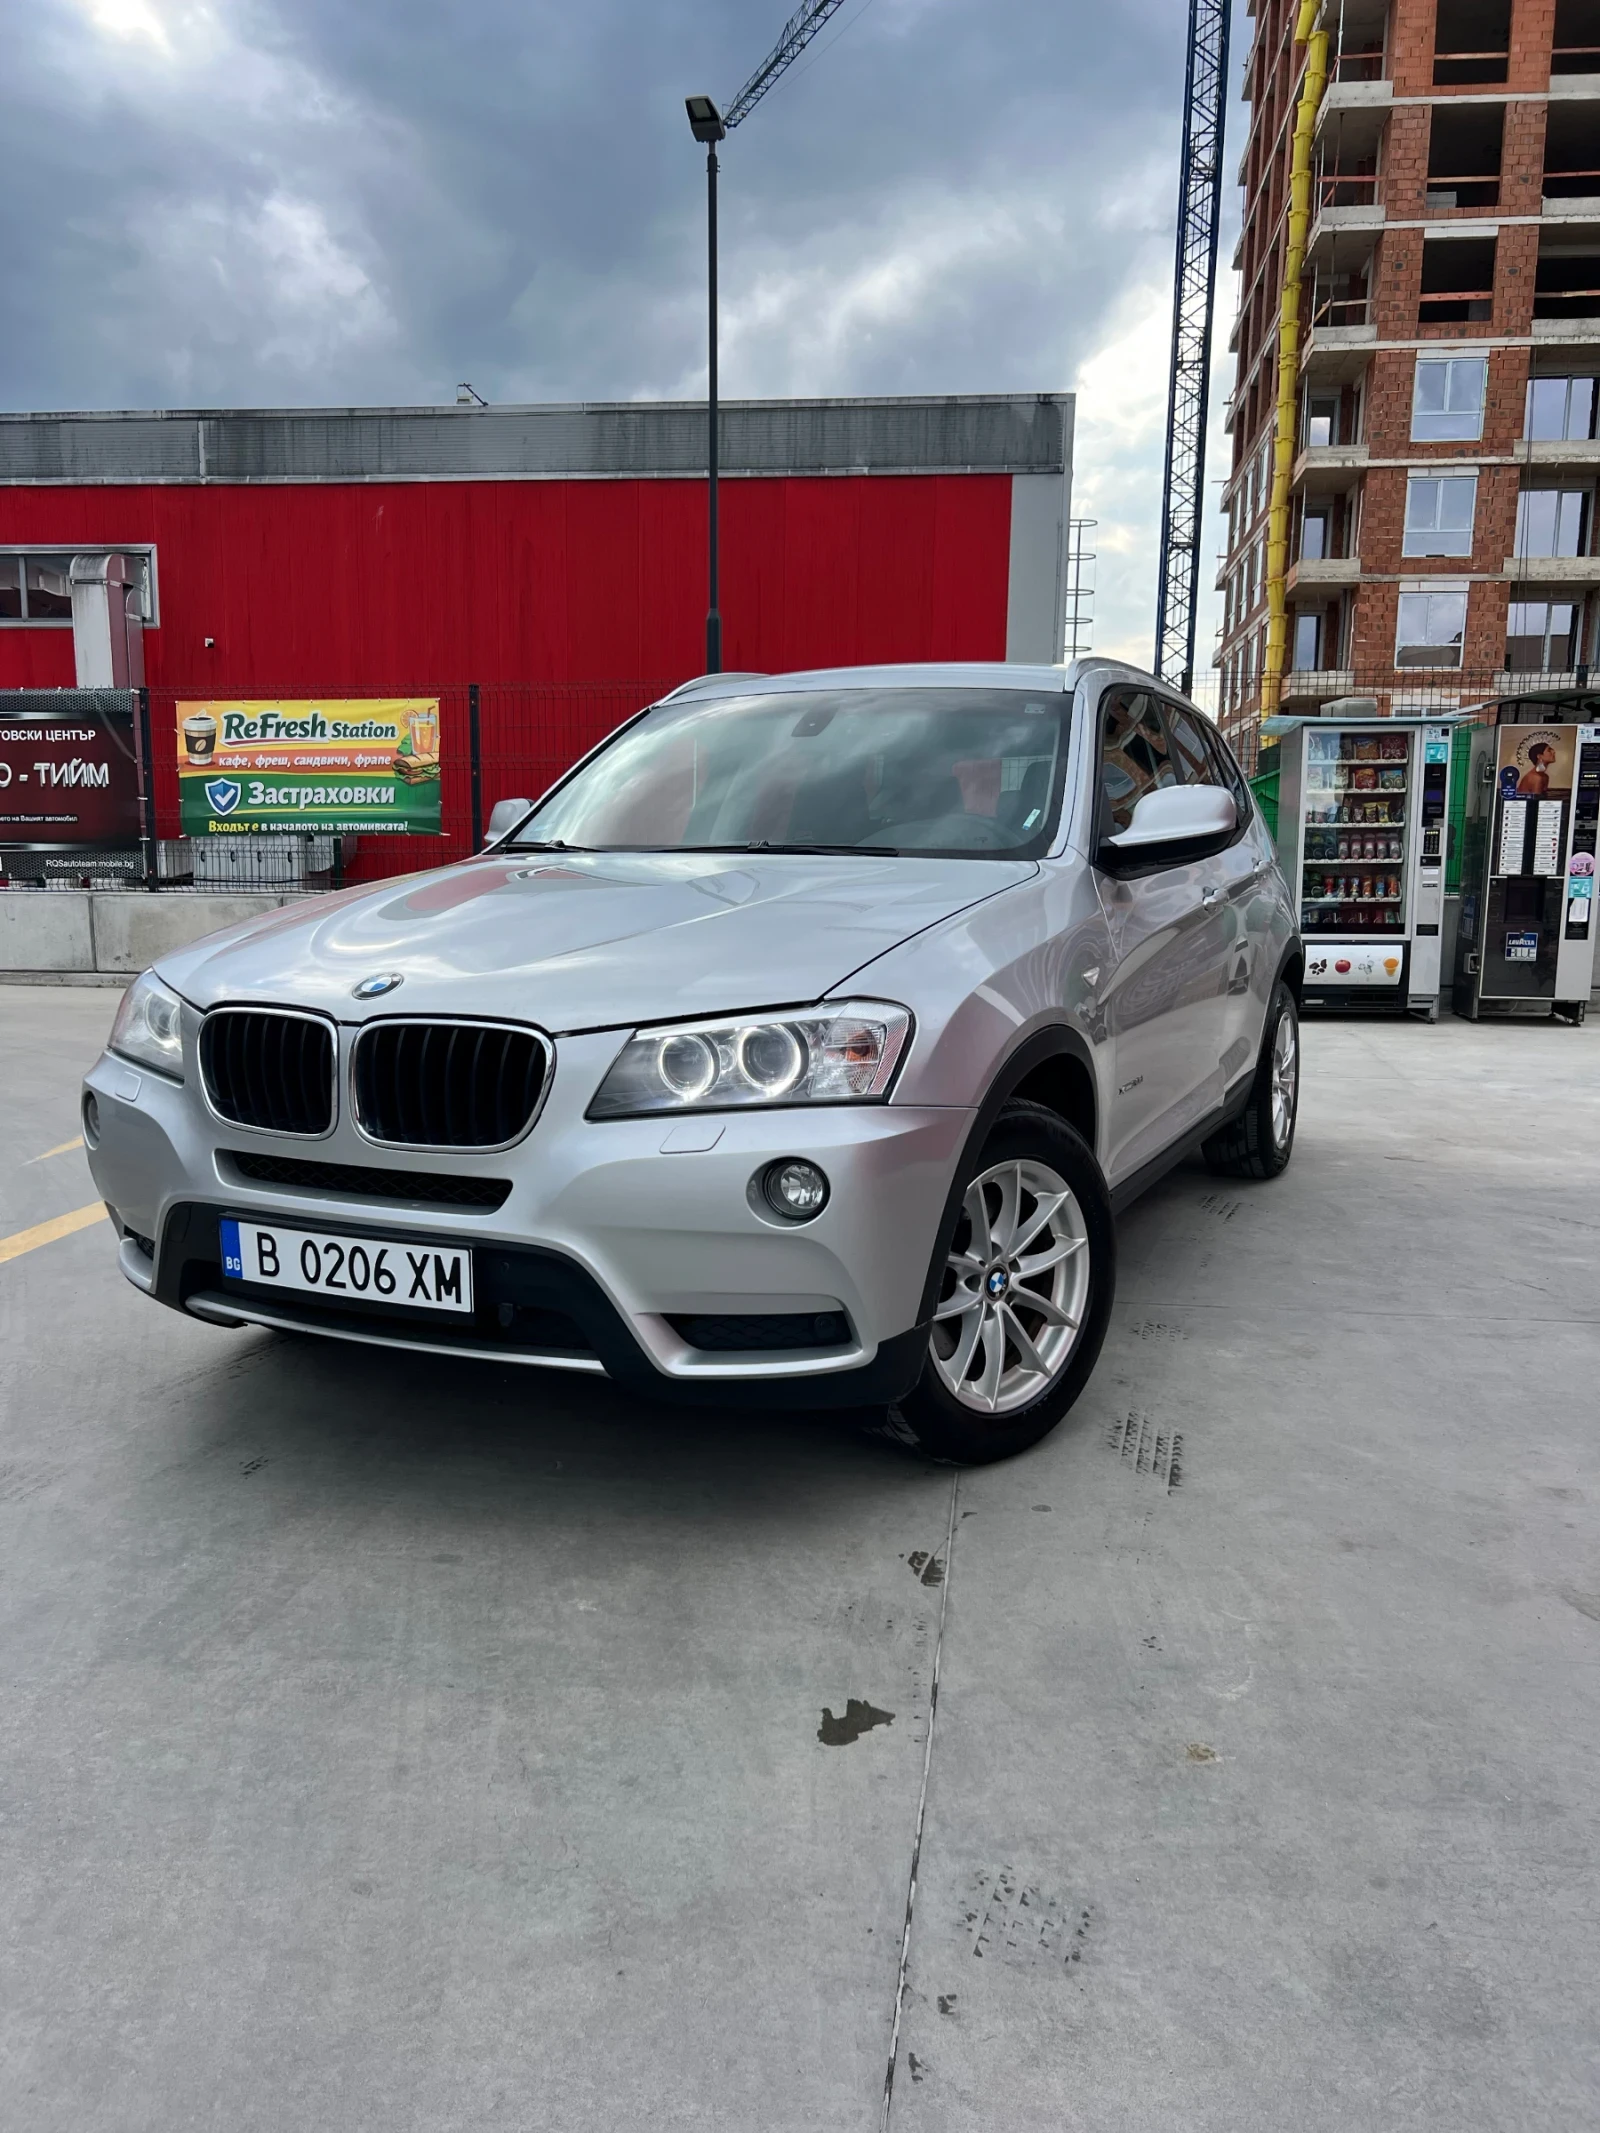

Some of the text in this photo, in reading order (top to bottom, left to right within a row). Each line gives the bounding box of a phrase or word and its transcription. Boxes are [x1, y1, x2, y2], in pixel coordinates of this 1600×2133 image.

[45, 730, 96, 742] ЦЕНТЪР
[223, 712, 396, 740] ReFresh Station
[218, 753, 392, 769] кафе, фреш, сандвичи, фрапе
[33, 758, 110, 788] ТИЙМ
[247, 781, 395, 810] Застраховки
[208, 820, 409, 833] Входът е в началото на автомивката!
[226, 1256, 241, 1271] BG
[256, 1231, 462, 1304] B 0206 XM
